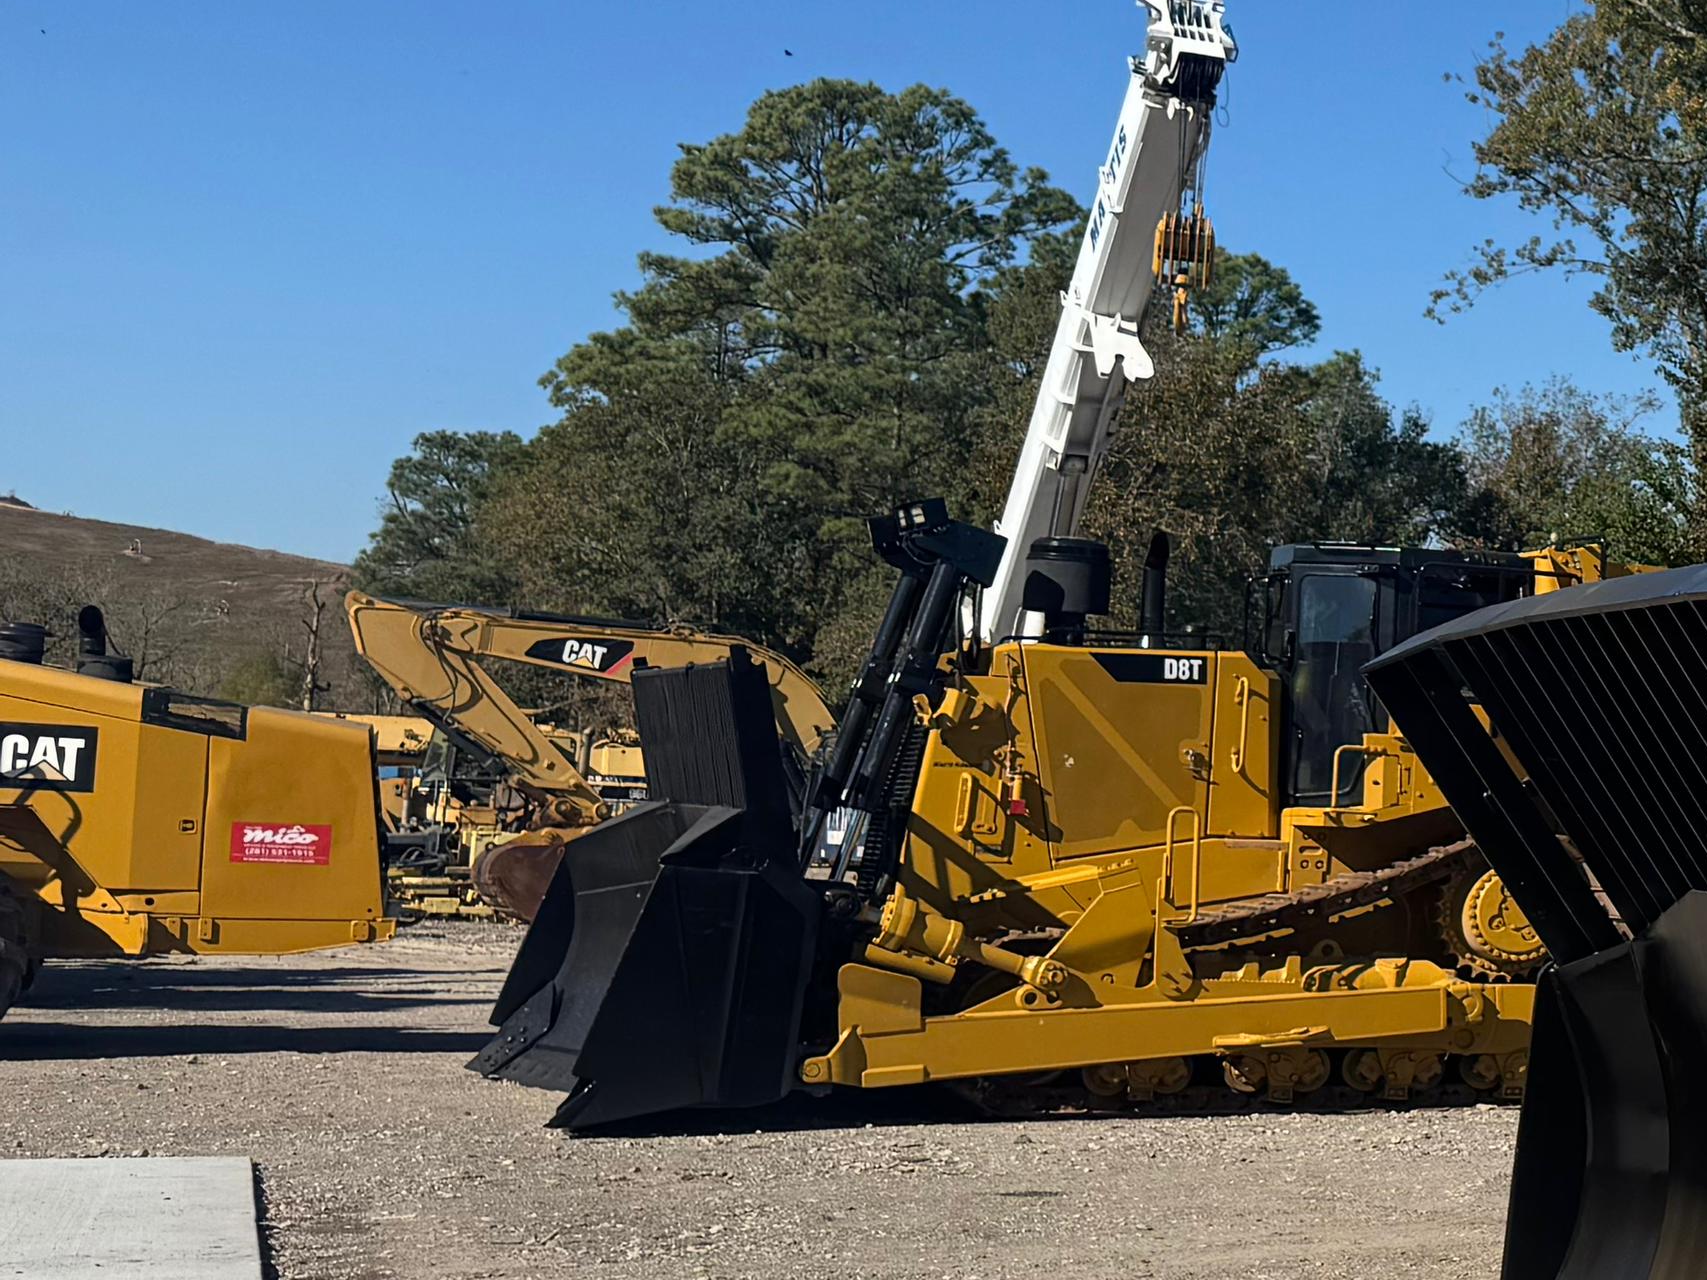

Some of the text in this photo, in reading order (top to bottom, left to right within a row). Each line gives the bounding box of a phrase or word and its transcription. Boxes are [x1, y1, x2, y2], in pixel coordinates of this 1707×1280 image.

[1089, 123, 1127, 254] MATIS
[562, 639, 608, 670] CAT
[1164, 658, 1203, 680] D8T
[1, 733, 86, 782] CAT
